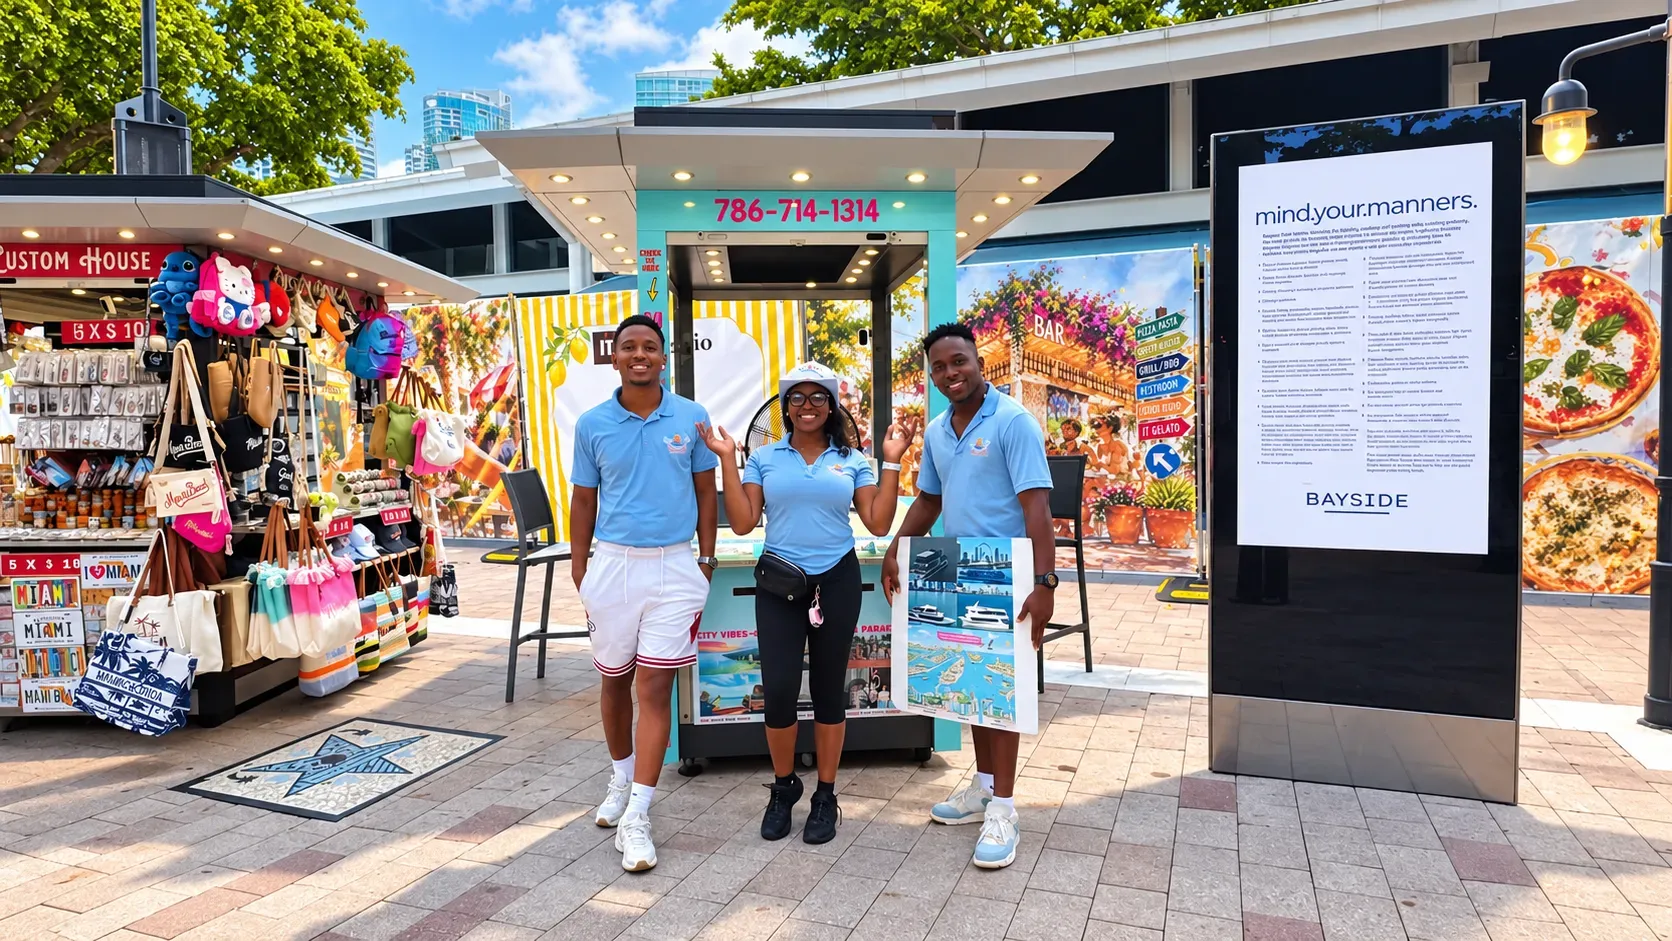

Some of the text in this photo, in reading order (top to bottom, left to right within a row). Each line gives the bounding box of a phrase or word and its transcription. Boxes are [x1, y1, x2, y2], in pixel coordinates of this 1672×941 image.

[714, 198, 880, 223] 786-714-1314
[1255, 193, 1478, 227] mind.your.manners.
[79, 246, 151, 274] HOUSE
[89, 322, 101, 340] X
[124, 321, 144, 339] 10
[1034, 314, 1066, 346] BAR
[1151, 422, 1180, 436] GELATO
[1306, 492, 1409, 508] BAYSIDE
[9, 559, 17, 570] 5
[26, 559, 36, 570] X
[84, 565, 89, 580] I
[24, 622, 74, 639] MIAMI
[697, 630, 718, 640] CITY
